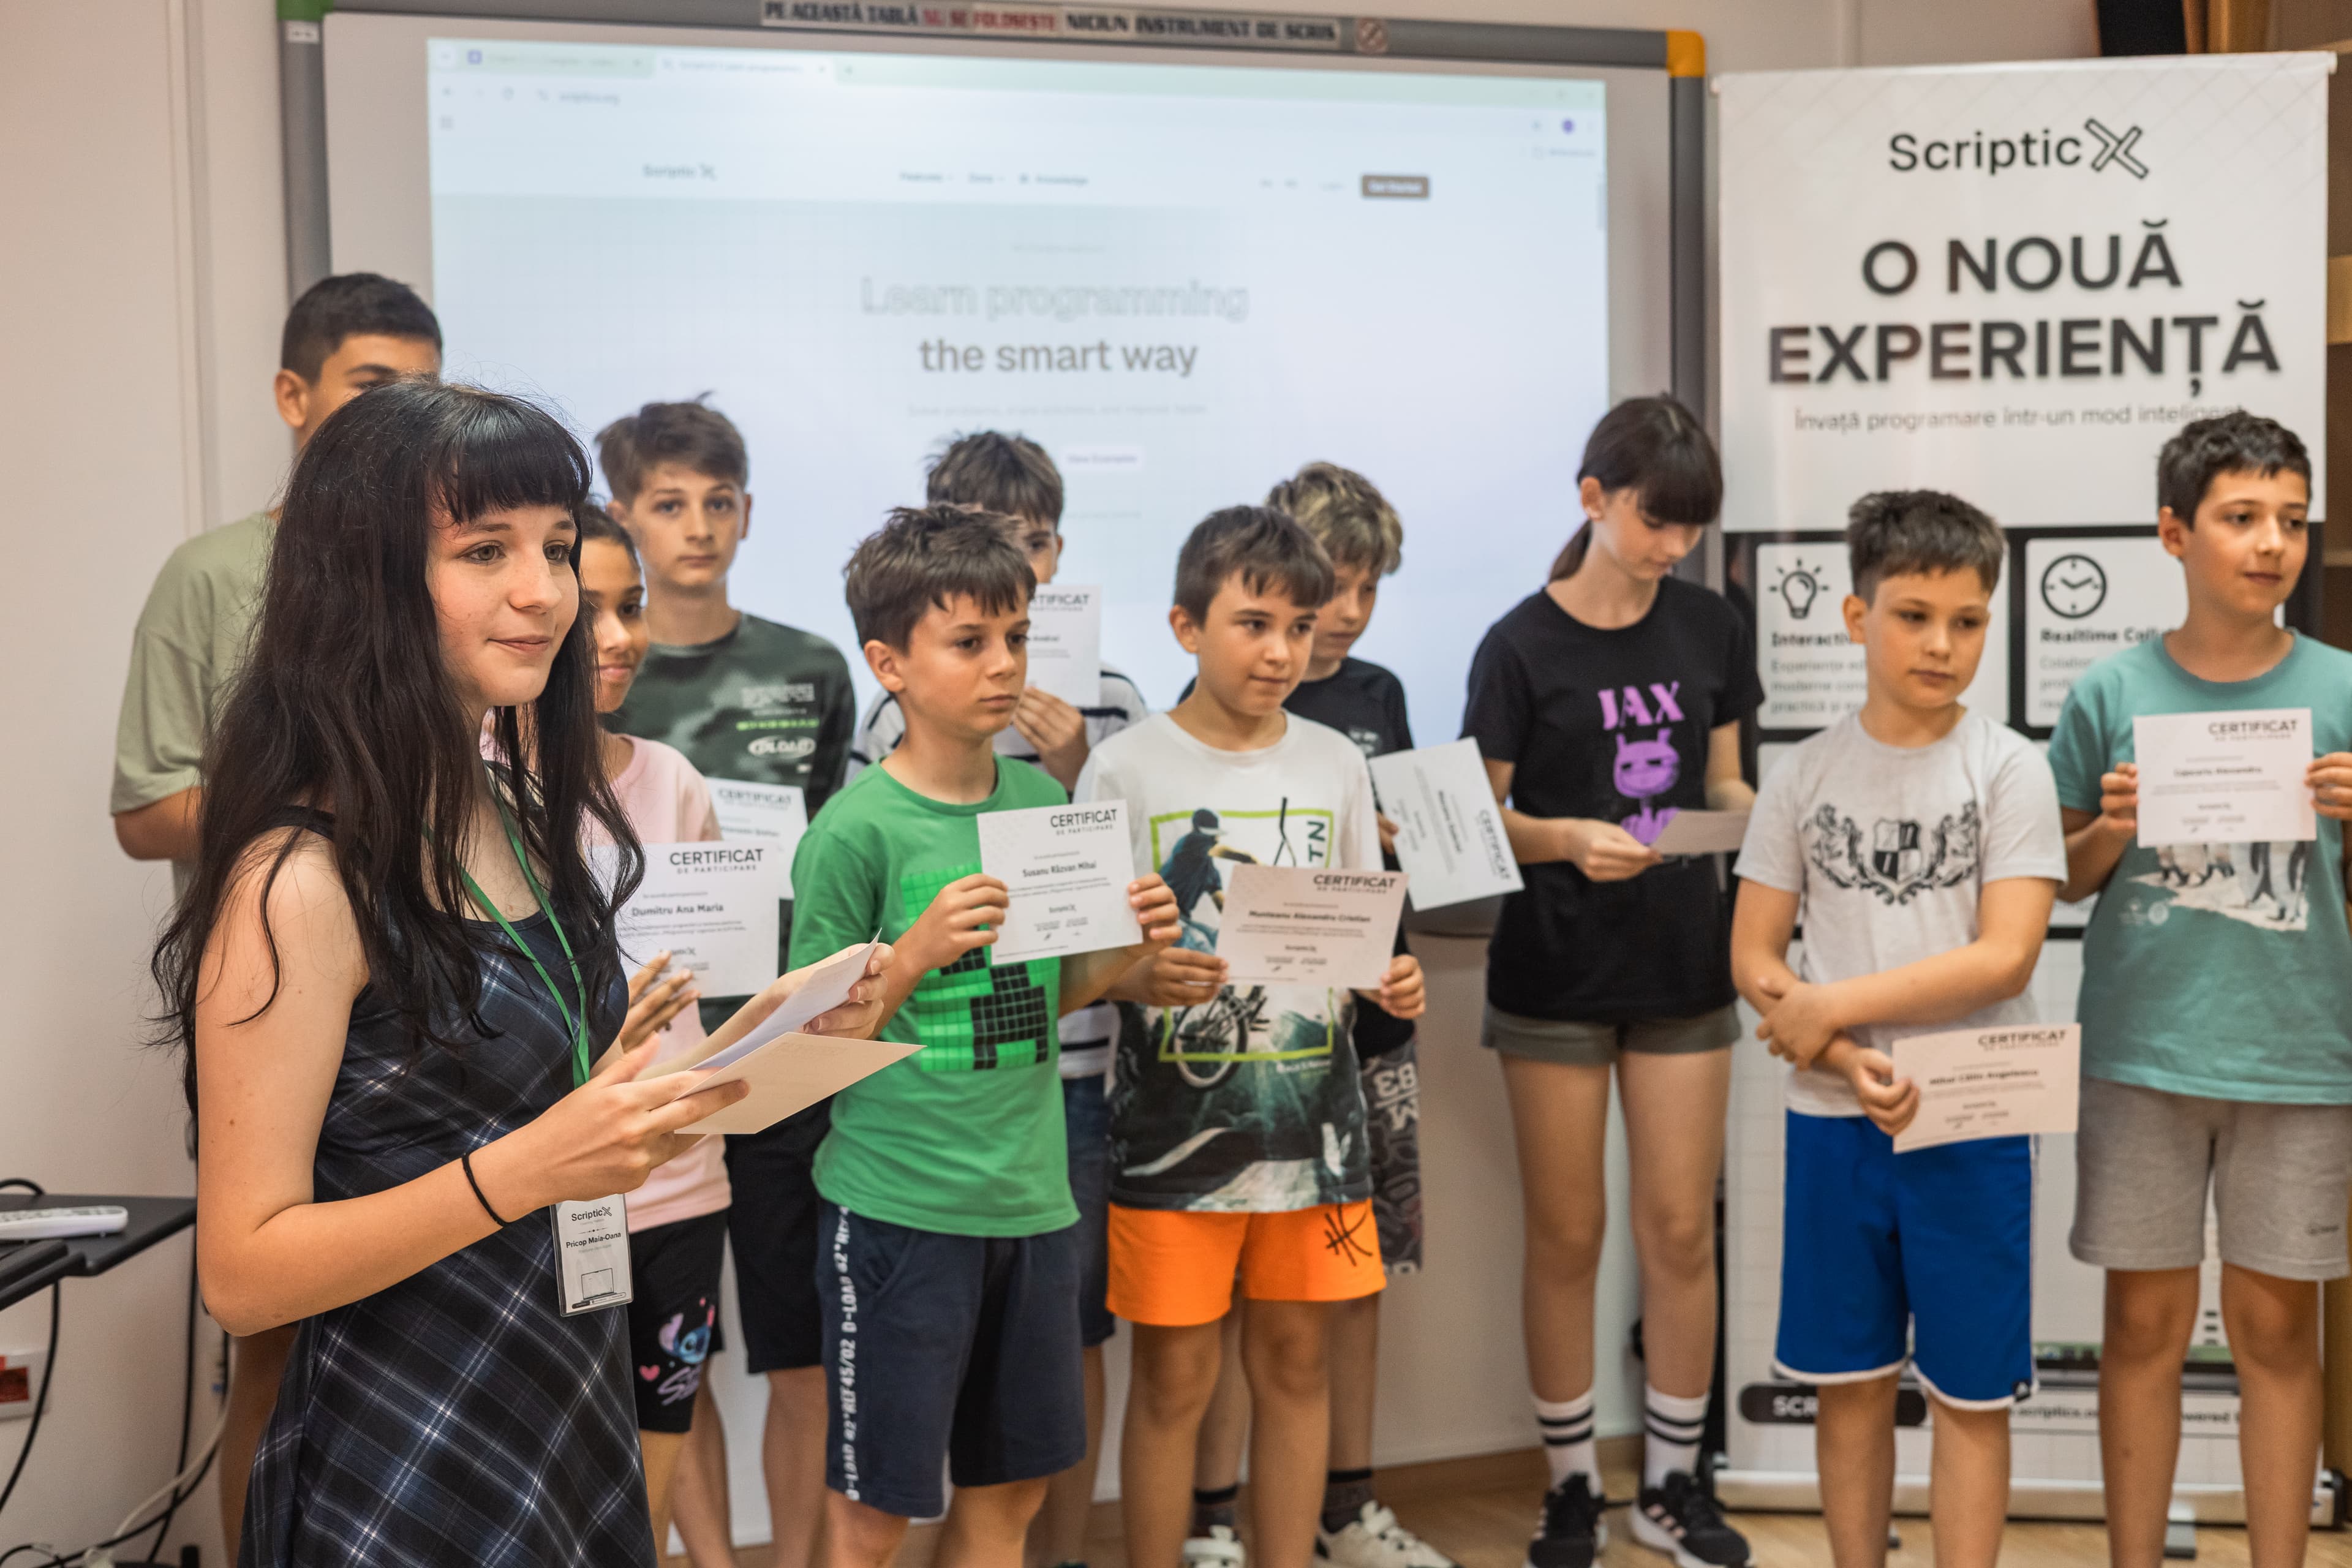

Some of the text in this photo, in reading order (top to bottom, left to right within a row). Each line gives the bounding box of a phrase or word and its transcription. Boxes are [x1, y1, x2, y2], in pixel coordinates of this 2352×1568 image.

[765, 2, 785, 19] PE
[1066, 13, 1128, 32] NICIUN
[1135, 15, 1251, 37] INSTRUMENT
[1256, 21, 1277, 38] DE
[1284, 23, 1336, 40] SCRIS
[1862, 218, 2183, 296] O NOUĂ
[860, 277, 1250, 323] Learn programming
[1768, 298, 2282, 397] EXPERIENȚĂ
[919, 339, 1199, 378] the smart way
[1867, 410, 1996, 435] programare
[2082, 405, 2132, 425] mod
[2040, 628, 2117, 643] Realtime
[1598, 680, 1684, 731] JAX
[2208, 718, 2298, 735] CERTIFICAT
[718, 789, 791, 804] CERTIFICAT
[1050, 809, 1117, 828] CERTIFICAT
[670, 848, 764, 865] CERTIFICAT
[1313, 873, 1396, 888] CERTIFICAT
[632, 902, 724, 916] Dumitru Ana Maria
[1978, 1029, 2067, 1046] CERTIFICAT
[566, 1232, 622, 1248] Pricop Maia-Oana
